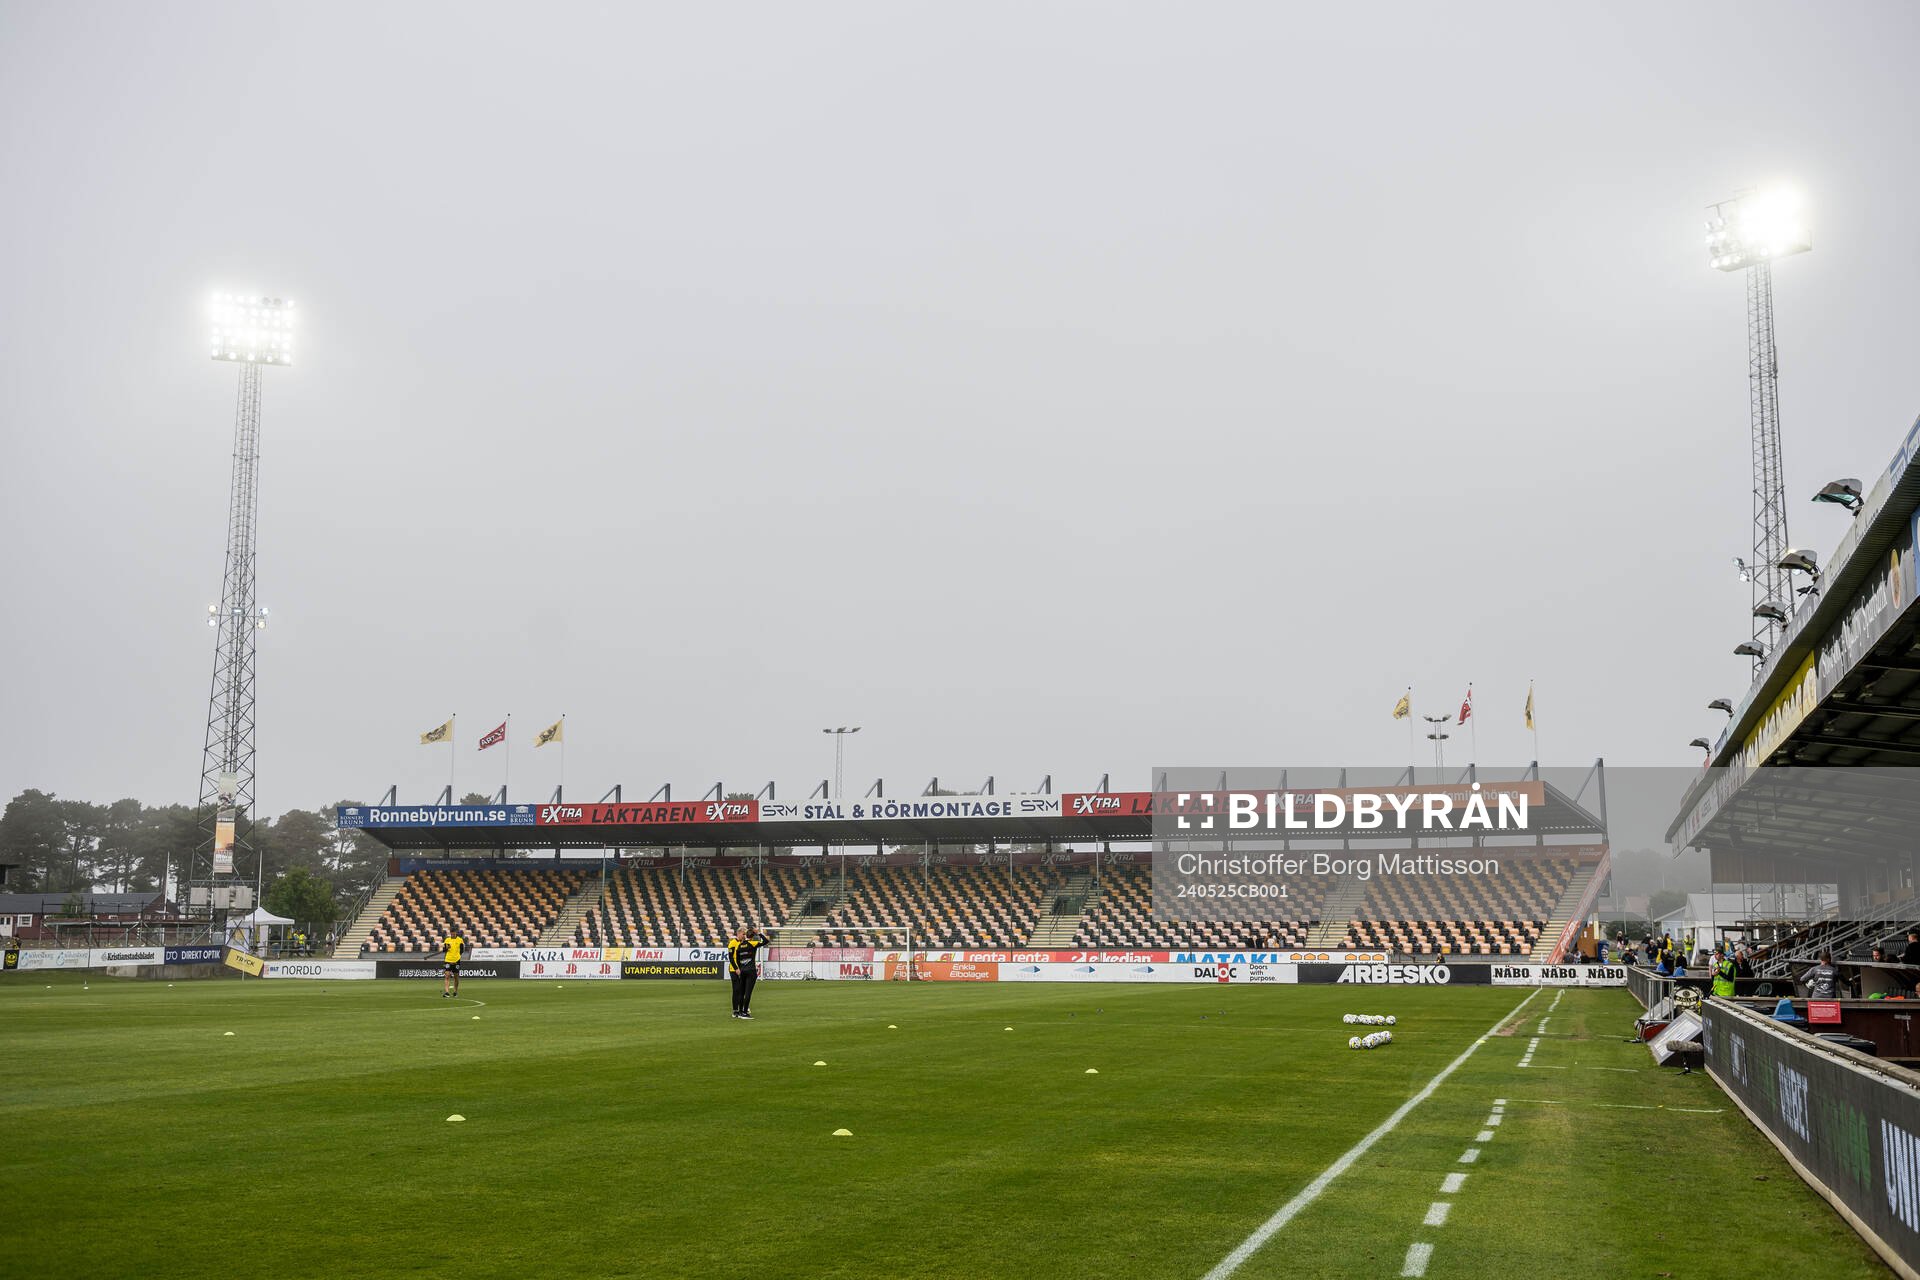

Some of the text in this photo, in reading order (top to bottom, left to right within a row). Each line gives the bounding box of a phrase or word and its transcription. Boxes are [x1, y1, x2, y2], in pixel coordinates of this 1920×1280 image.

[762, 800, 1059, 819] SRM STÅL & RÖRMONTAGE SRM
[1072, 794, 1121, 815] EXTRA
[369, 808, 506, 825] Ronnebybrunn.se
[541, 802, 749, 823] EXTRA LÄKTAREN EXTRA
[107, 952, 155, 961] Kristianstadsbladet
[181, 950, 203, 960] DIREKT
[203, 950, 221, 959] OPTIK
[521, 949, 564, 961] SÄKRA
[704, 949, 729, 961] Tark
[969, 952, 1007, 962] renta
[1012, 952, 1050, 962] renta
[1175, 953, 1278, 964] MATAKI
[282, 965, 322, 975] NORDLO
[459, 968, 497, 977] BROMÖLLA
[533, 963, 544, 974] JB
[566, 963, 577, 974] JB
[599, 963, 611, 974] JB
[625, 966, 718, 975] UTANFÖR REKTANGELN
[839, 963, 874, 976] MAXI
[1194, 968, 1237, 978] DALOC
[1494, 965, 1530, 978] NÄBO
[1541, 965, 1577, 978] NÄBO
[1588, 965, 1624, 978] NÄBO
[950, 970, 990, 981] Elbolaget
[1337, 965, 1451, 984] ARBESKO
[1881, 1118, 1920, 1235] UNI
